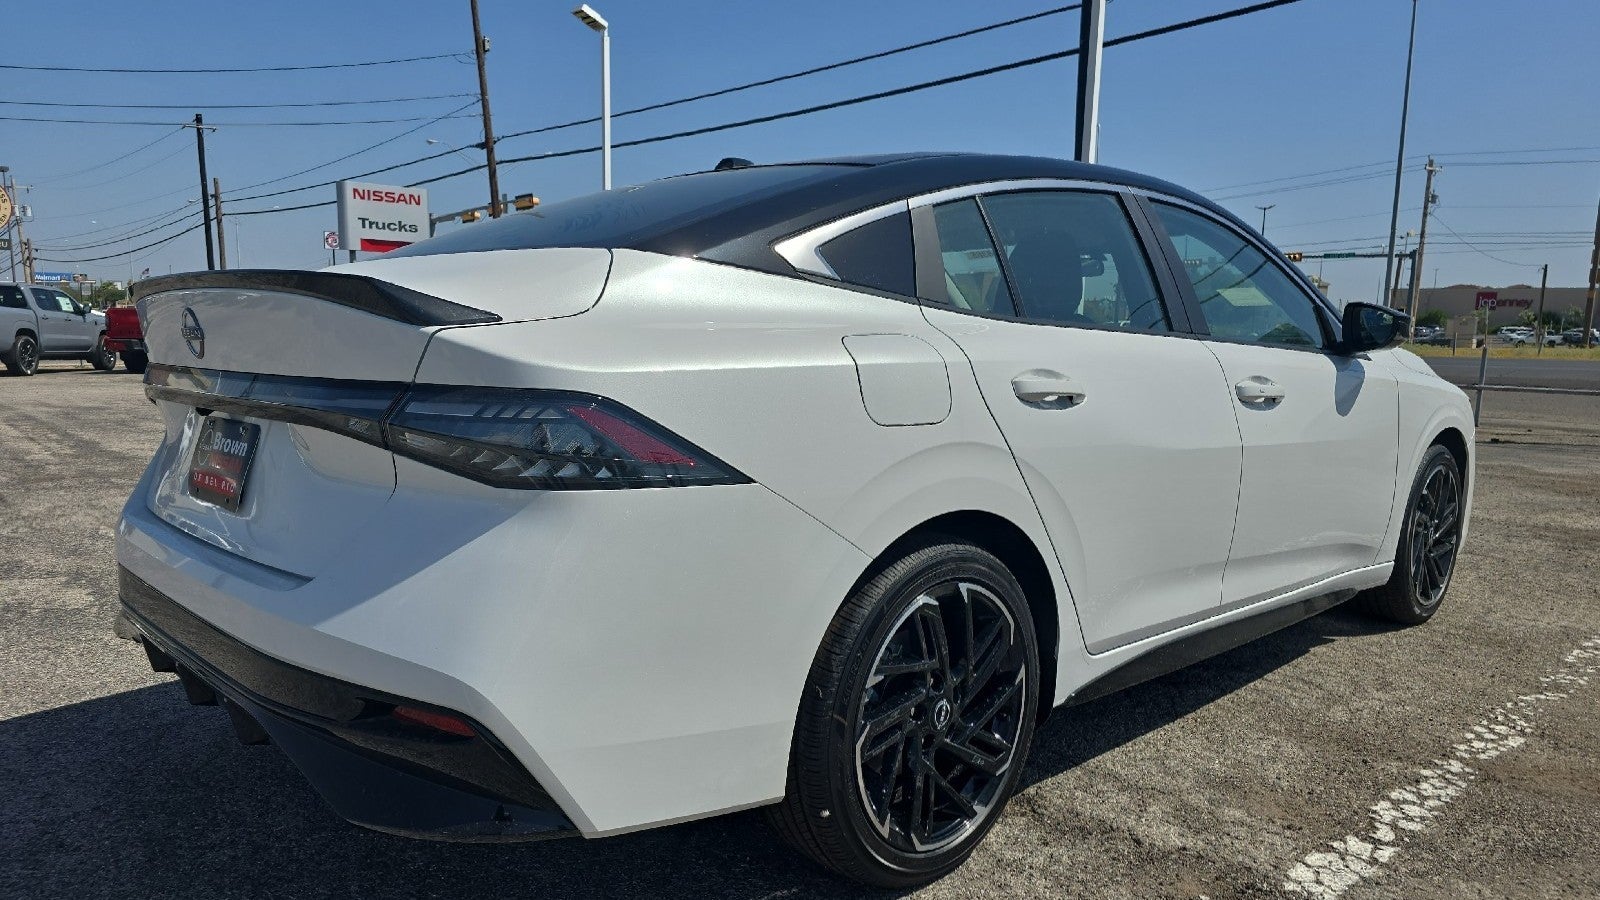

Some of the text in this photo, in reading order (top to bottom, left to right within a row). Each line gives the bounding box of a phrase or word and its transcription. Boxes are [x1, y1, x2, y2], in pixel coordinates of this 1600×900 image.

[353, 188, 421, 206] NISSAN
[358, 217, 418, 233] Trucks
[1477, 296, 1533, 310] jcpenney
[213, 431, 248, 456] Brown
